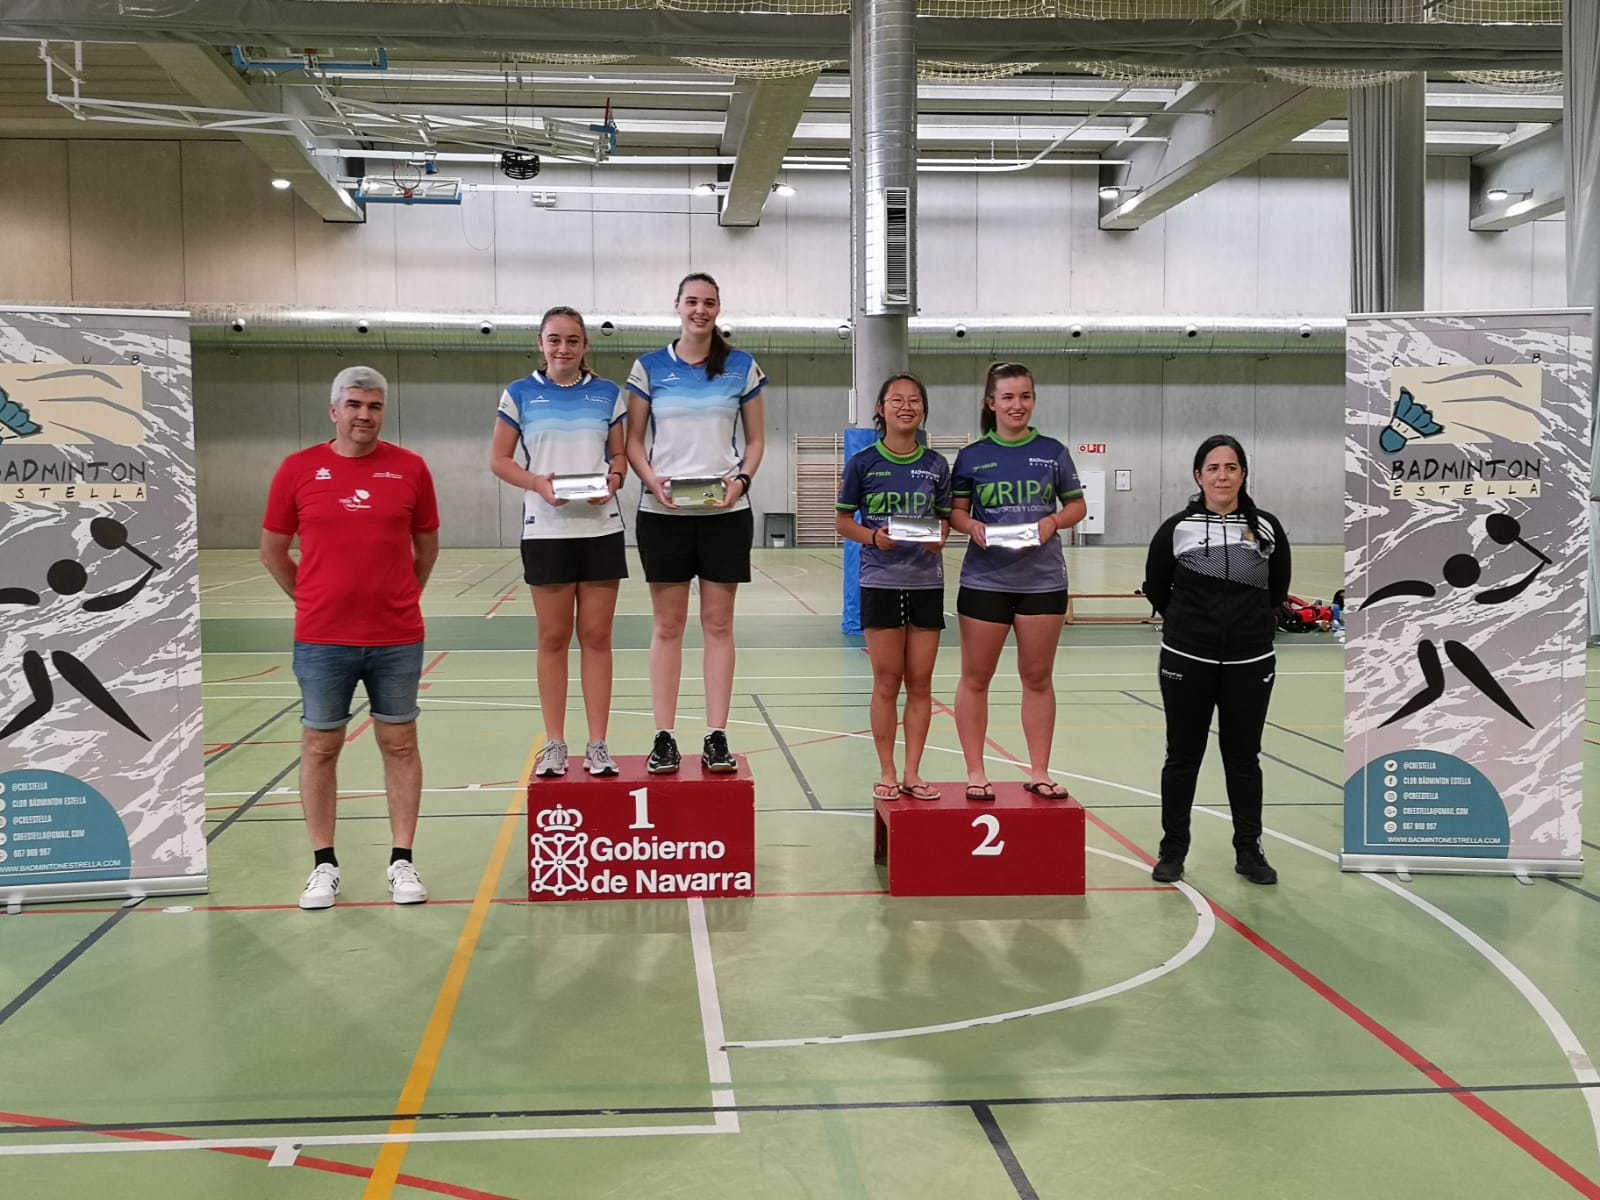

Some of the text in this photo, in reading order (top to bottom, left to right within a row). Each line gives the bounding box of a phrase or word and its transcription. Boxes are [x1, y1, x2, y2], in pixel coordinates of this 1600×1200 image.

[1392, 353, 1541, 367] CLUB
[0, 459, 146, 482] ADMINTON
[1390, 459, 1541, 481] BADMINTON
[1393, 483, 1538, 497] ESTELLA
[1403, 777, 1417, 785] CLUB
[12, 799, 28, 808] CLUB
[628, 786, 655, 829] 1
[971, 814, 1006, 856] 2
[1388, 836, 1501, 845] WWW.BADMINTONESTRELLA.COM
[590, 836, 726, 862] Gobierno
[591, 869, 752, 894] de Navarra
